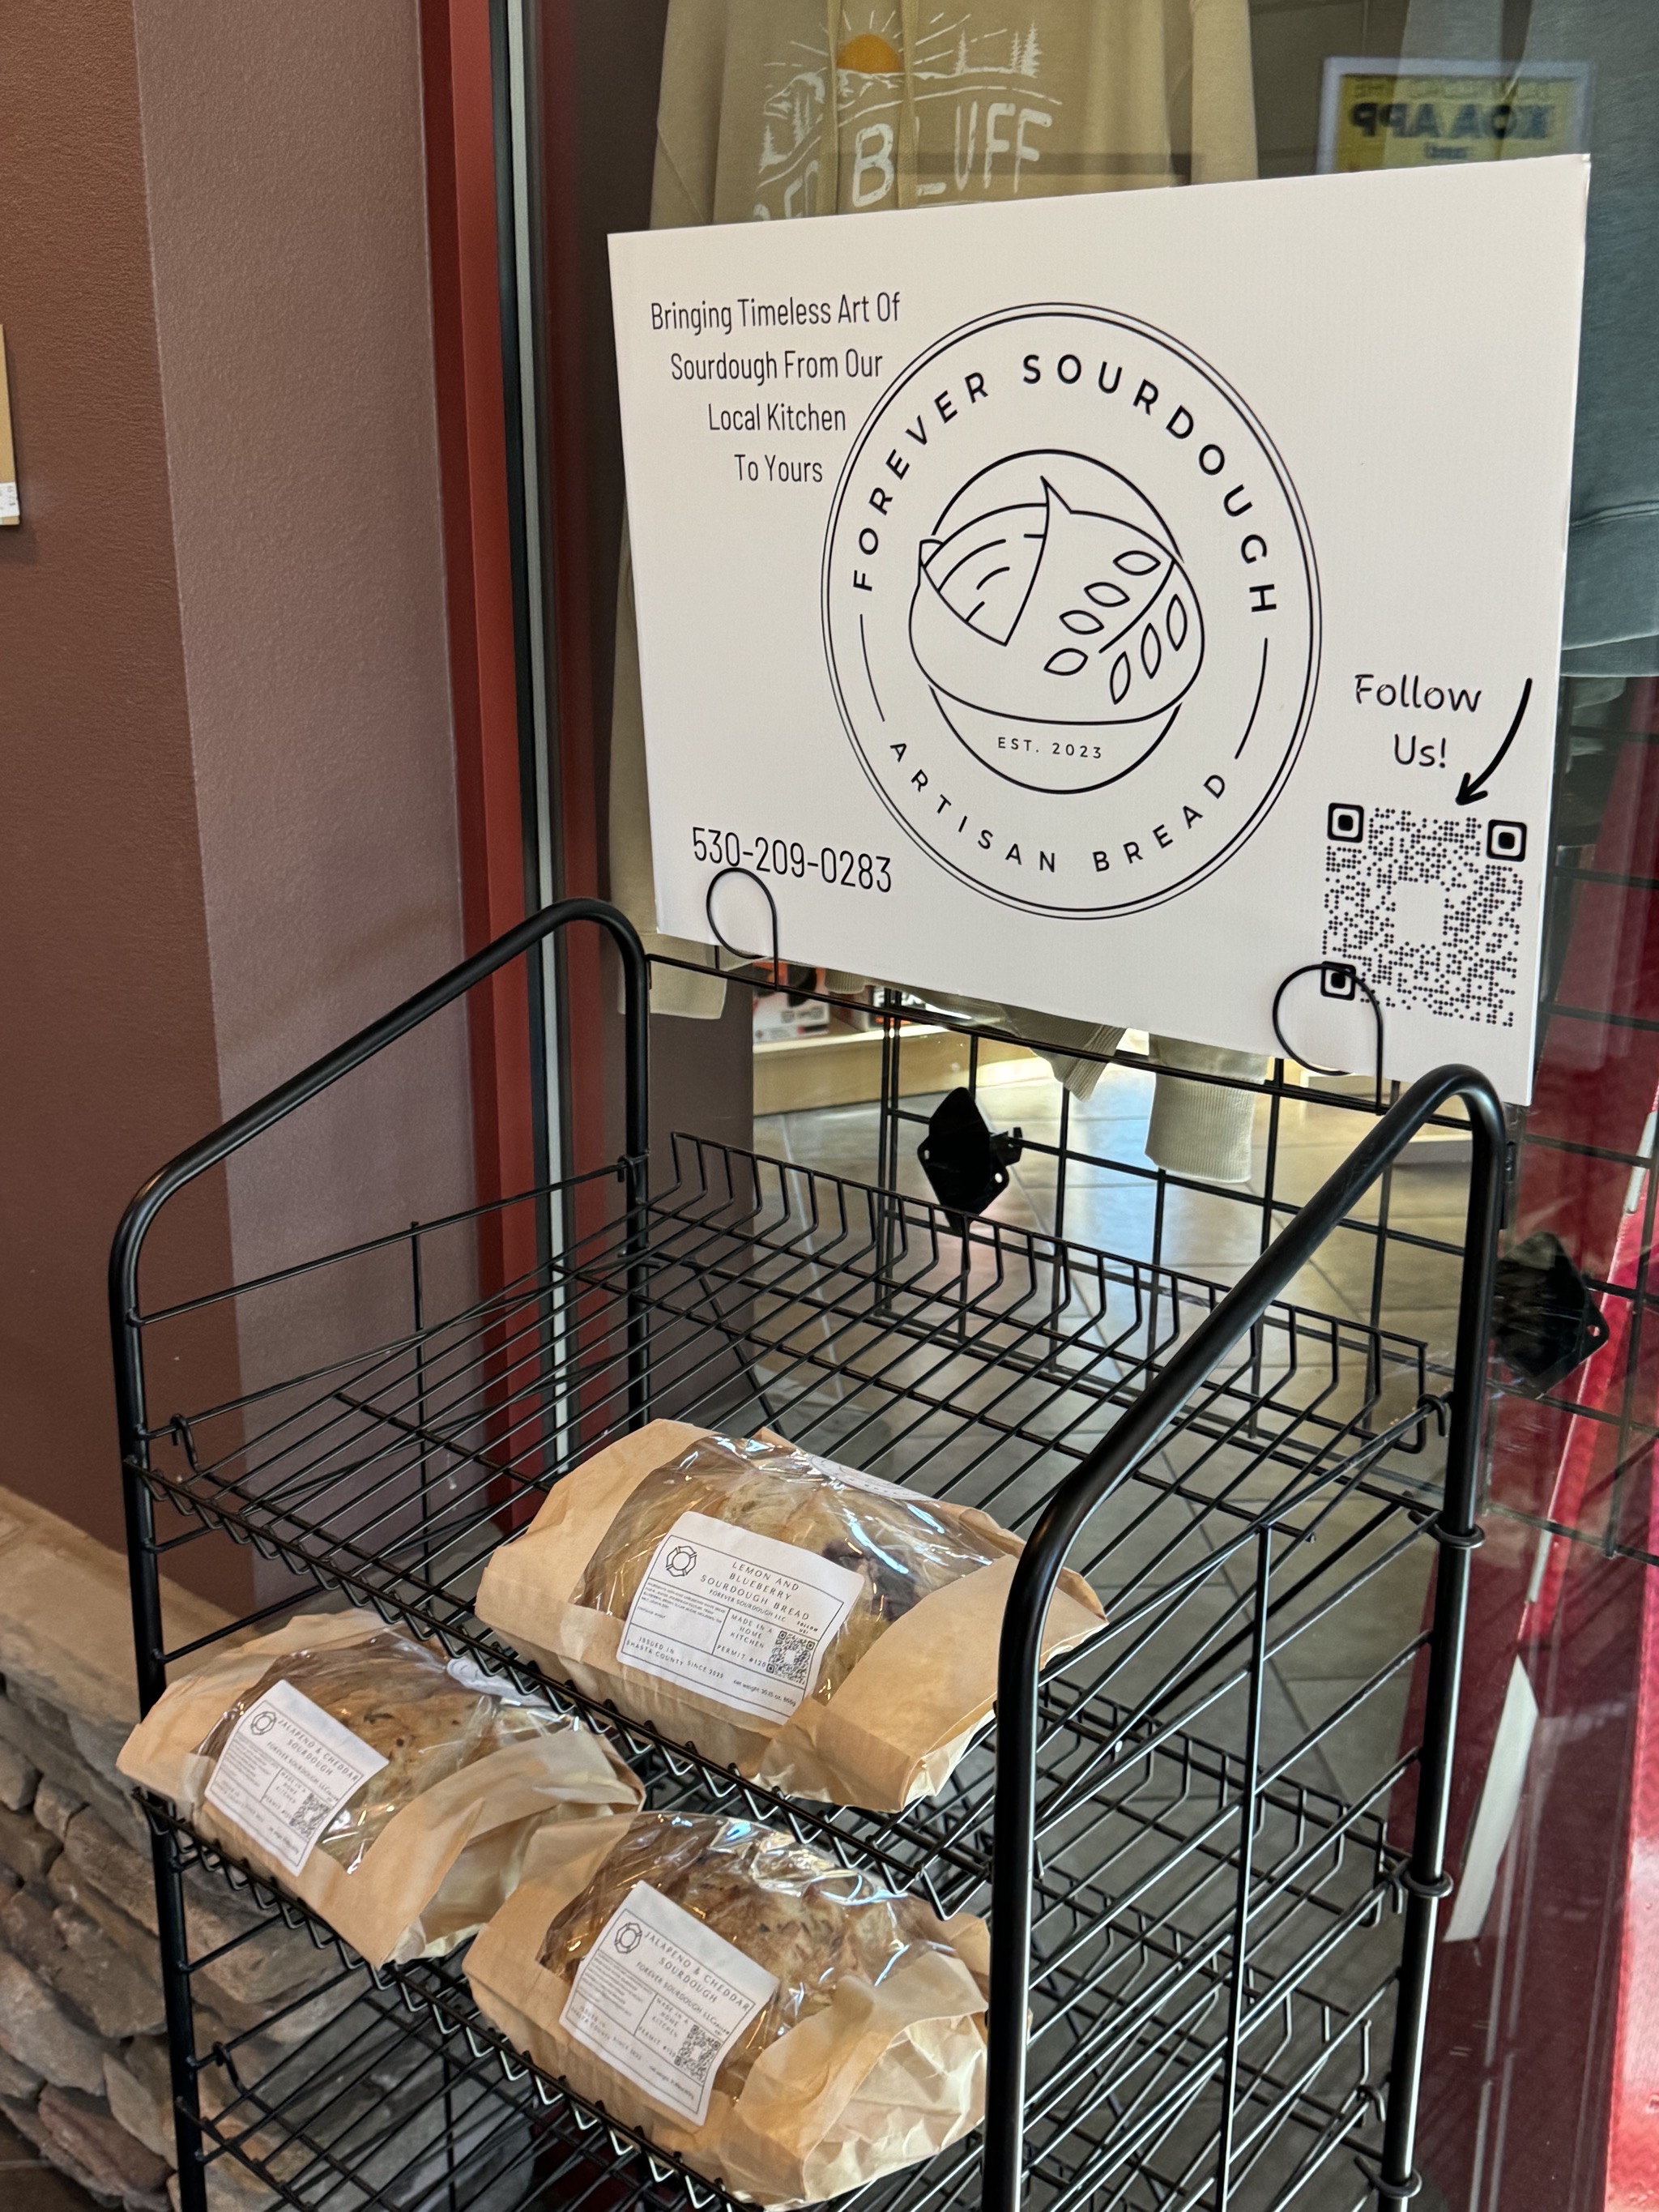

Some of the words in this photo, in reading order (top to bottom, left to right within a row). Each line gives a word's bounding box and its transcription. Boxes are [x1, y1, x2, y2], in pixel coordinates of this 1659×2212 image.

[651, 301, 731, 335] Bringing
[738, 297, 831, 327] Timeless
[838, 293, 869, 323] Art
[877, 292, 900, 322] Of
[671, 352, 777, 386] Sourdough
[784, 350, 838, 378] From
[846, 348, 883, 378] Our
[708, 404, 760, 430] Local
[768, 404, 846, 430] Kitchen
[734, 454, 758, 480] To
[765, 455, 823, 482] Yours
[853, 372, 988, 591] FOREVER
[1022, 354, 1277, 612] SOURDOUGH
[1354, 674, 1482, 712] Follow
[998, 737, 1039, 753] EST.
[1052, 742, 1102, 759] 2023
[1394, 733, 1446, 769] Us!
[889, 741, 1056, 873] ARTISAN
[1093, 775, 1226, 873] BREAD
[693, 826, 891, 892] 530-209-0283
[730, 1572, 791, 1602] BLUEBERRY
[732, 1561, 770, 1582] LEMON
[776, 1577, 799, 1592] AND
[701, 1574, 768, 1607] SOURDOUGH
[774, 1601, 809, 1621] BREAD
[710, 1589, 734, 1603] FOREVER
[736, 1599, 772, 1617] SOURDOUGH
[731, 1614, 752, 1626] MADE
[731, 1631, 764, 1648] KITCHEN
[278, 1718, 315, 1749] JALAPENO
[323, 1753, 359, 1782] CHEDDAR
[287, 1739, 334, 1776] SOURDOUGH
[644, 1931, 692, 1969] JALAPENO
[693, 1966, 702, 1975] &
[703, 1974, 750, 2012] CHEDDAR
[659, 1957, 719, 2003] SOURDOUGH
